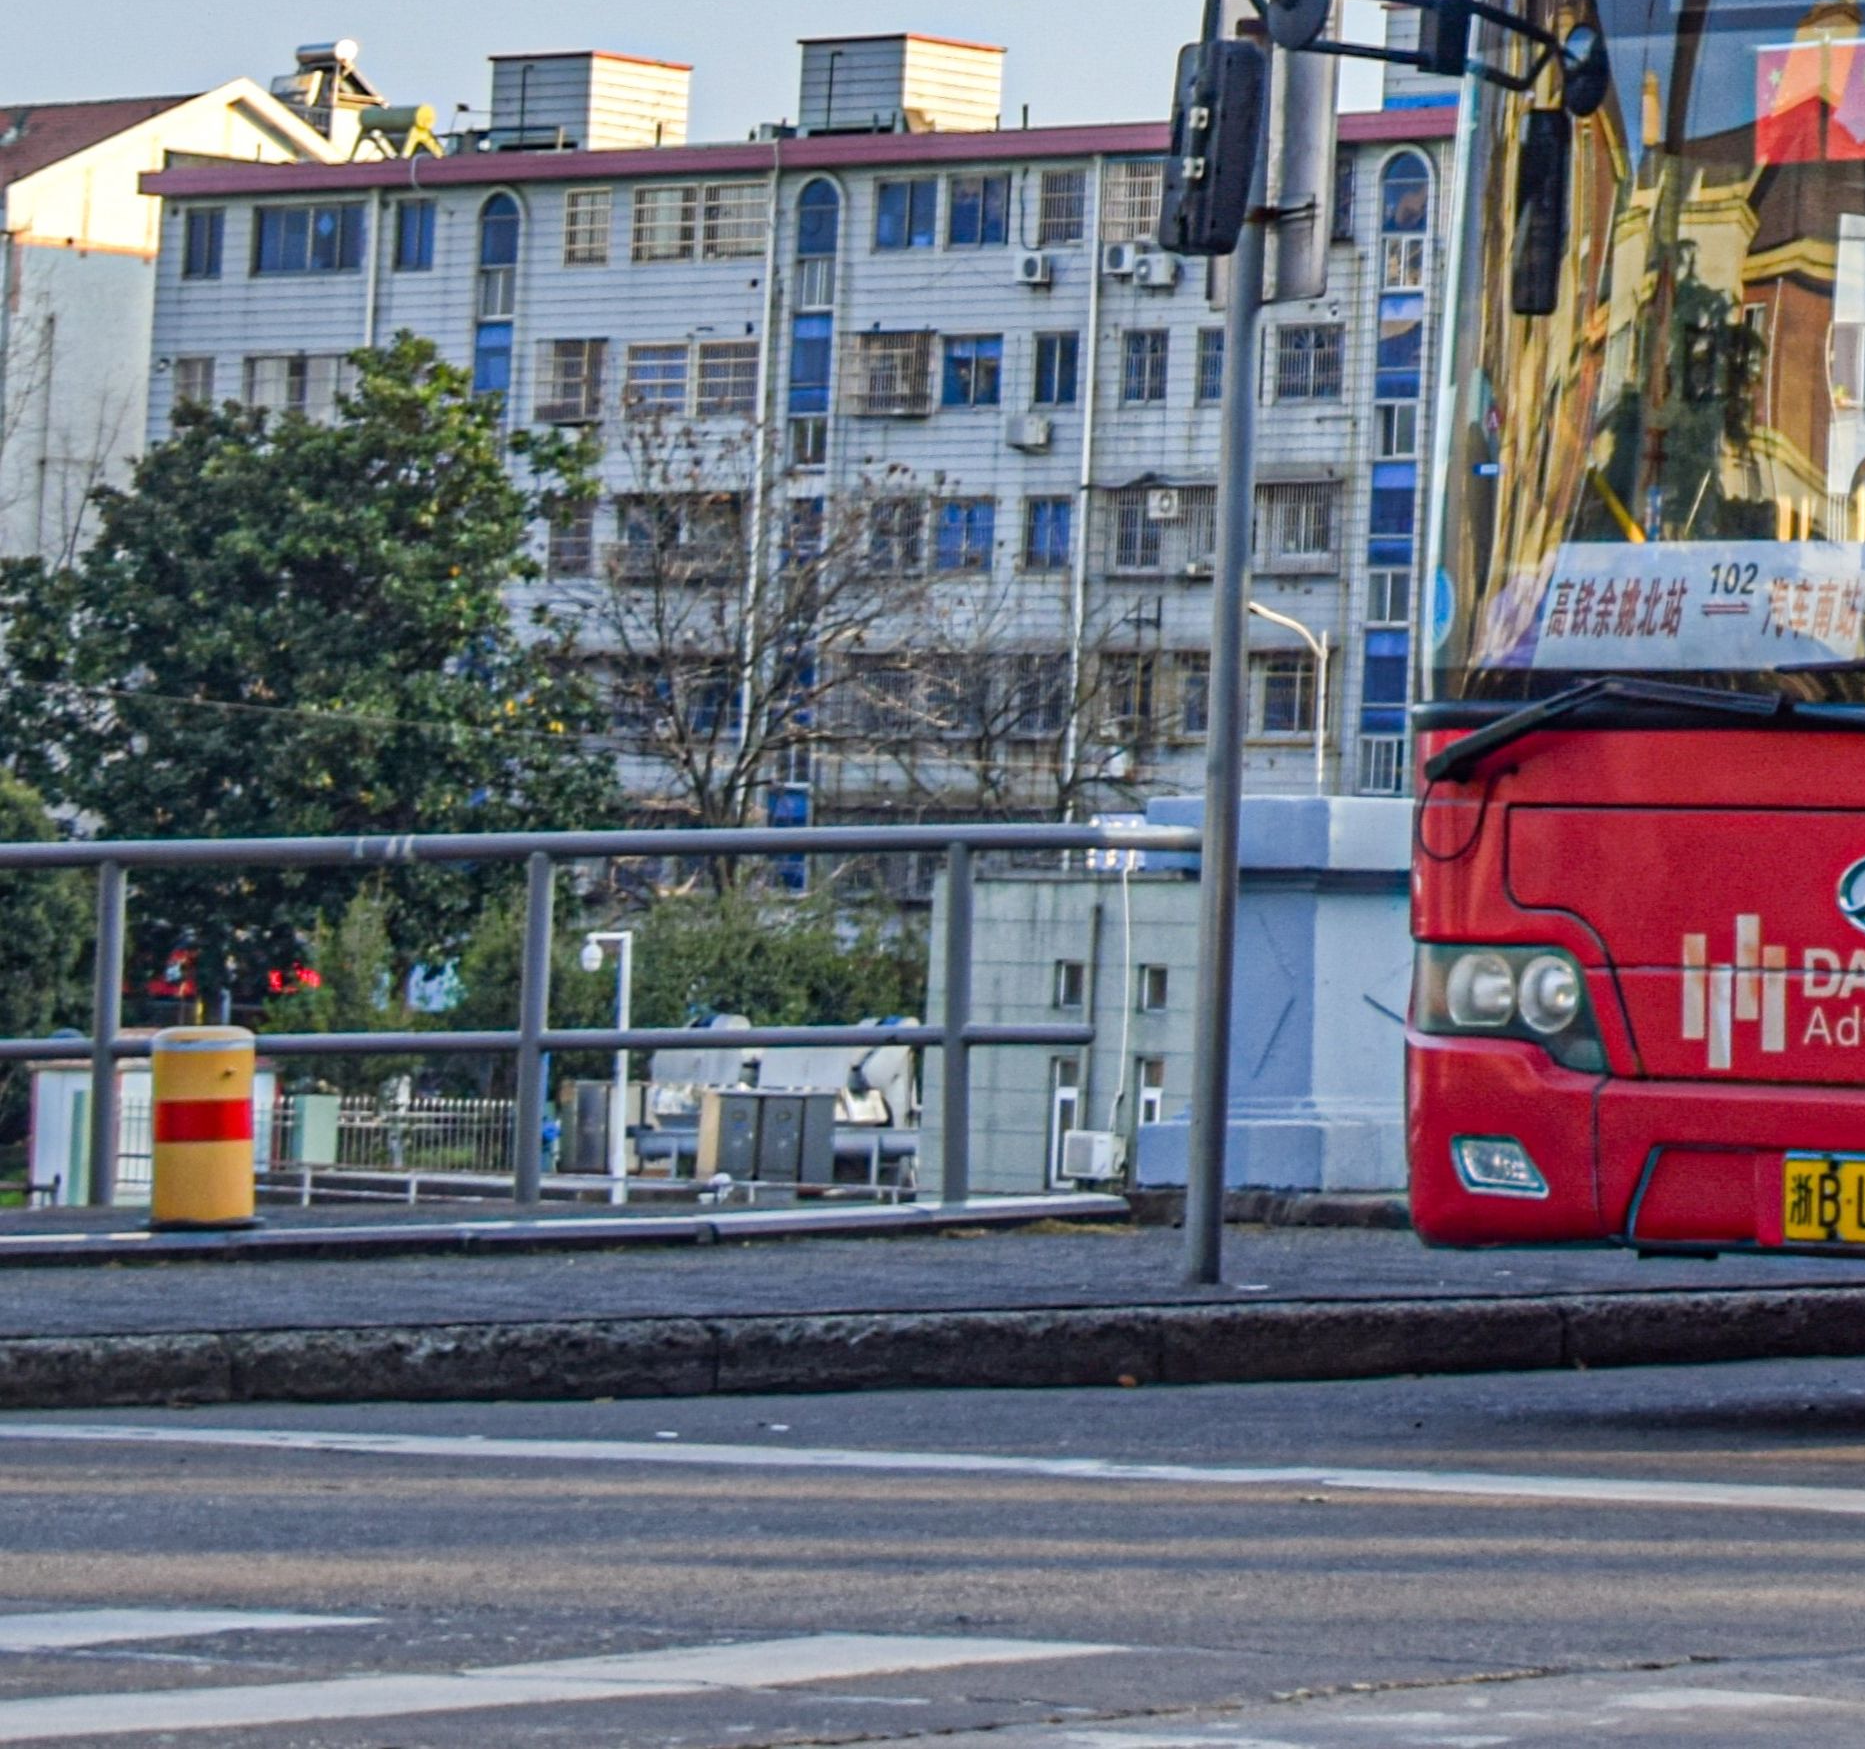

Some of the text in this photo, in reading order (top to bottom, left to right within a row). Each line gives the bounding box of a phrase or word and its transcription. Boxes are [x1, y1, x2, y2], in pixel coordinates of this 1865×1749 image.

[1709, 562, 1758, 595] 102
[1546, 577, 1863, 642] 高铁余姚北站 汽车南站
